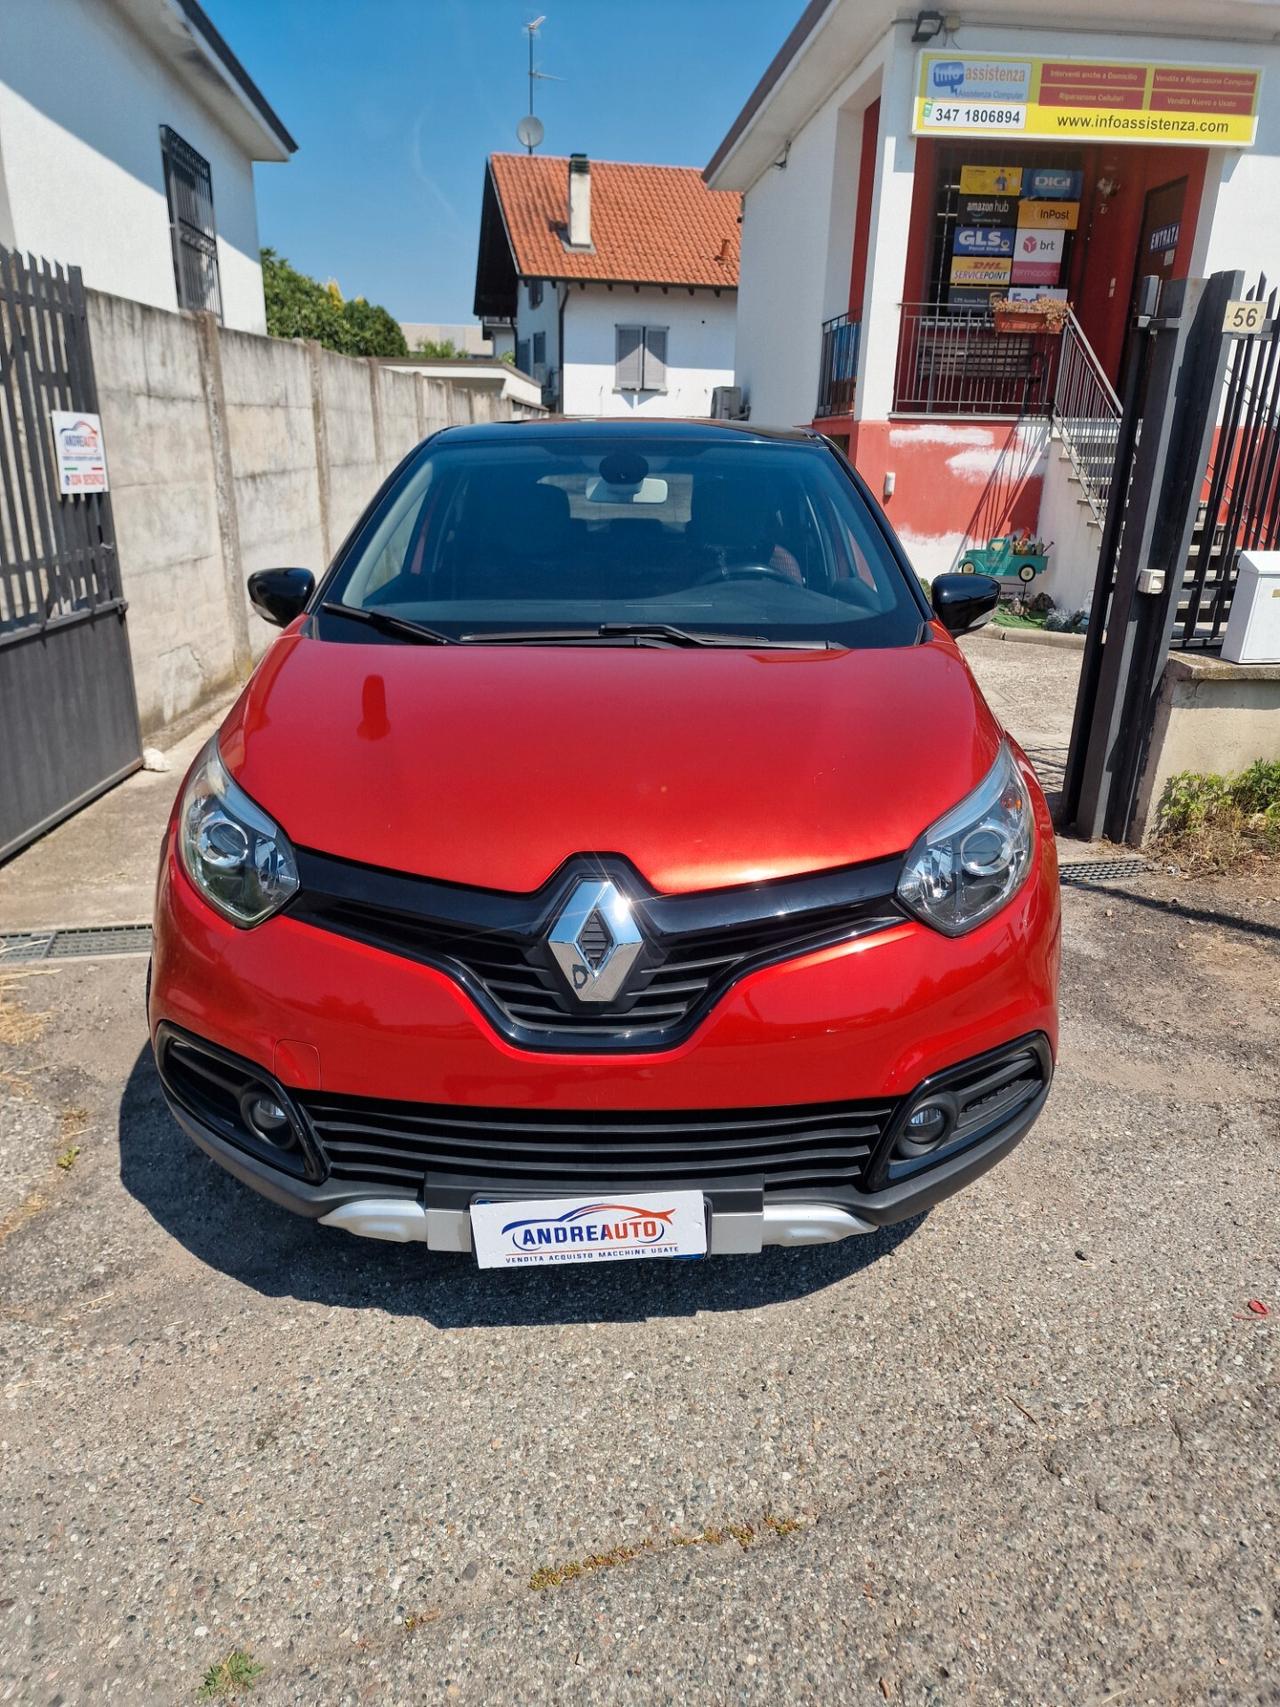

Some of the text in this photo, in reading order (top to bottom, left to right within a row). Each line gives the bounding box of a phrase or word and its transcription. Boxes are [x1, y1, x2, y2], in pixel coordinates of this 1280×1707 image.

[935, 108, 1020, 124] 347 1806894
[1057, 114, 1229, 133] www.infoassistenza.com
[1034, 176, 1071, 187] DIGI
[967, 200, 1009, 213] amazon hub
[1040, 209, 1070, 220] InPost
[958, 230, 1001, 246] GLS
[1039, 240, 1055, 250] brt
[1151, 225, 1179, 249] ENTRATA
[972, 261, 1001, 270] DHL
[954, 271, 1007, 280] SERVICEPOINT
[1233, 308, 1258, 328] 56
[522, 1220, 657, 1246] ANDREAUTO
[505, 1246, 679, 1263] VENDITA ACQUISTO MACCHINE USATE
